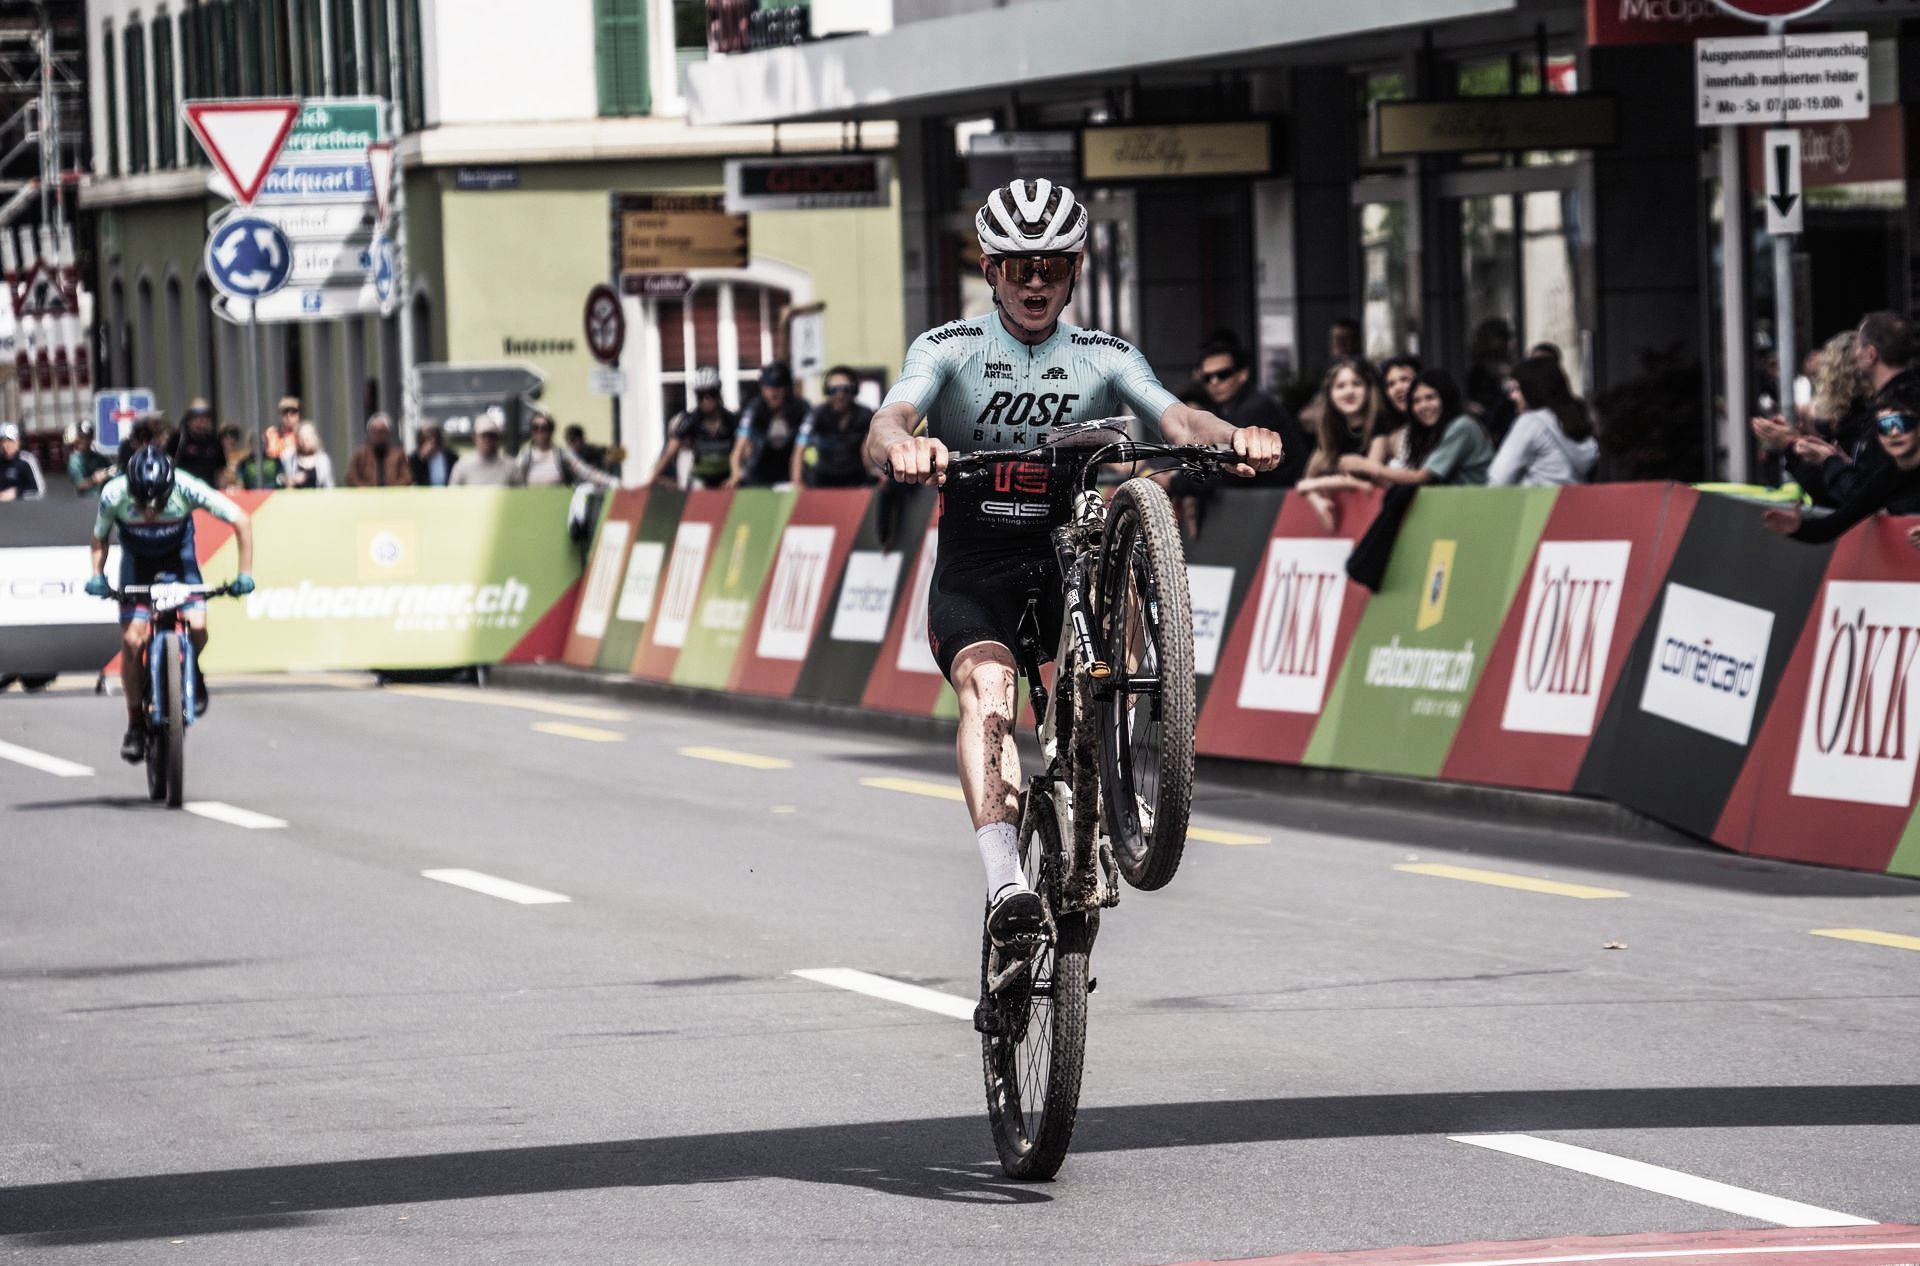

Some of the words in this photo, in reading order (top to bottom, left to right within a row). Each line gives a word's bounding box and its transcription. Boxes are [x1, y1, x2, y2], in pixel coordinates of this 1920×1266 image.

[1618, 0, 1722, 23] McOpt
[1701, 49, 1782, 65] Ausgenommen
[1706, 74, 1758, 88] innerhalb
[1760, 72, 1822, 86] markierten
[1825, 70, 1859, 84] Felder
[1718, 100, 1736, 113] Mo
[266, 165, 354, 195] ndquart
[926, 324, 984, 345] Traduction
[1070, 332, 1130, 353] Traduction
[984, 371, 1000, 379] ART
[985, 361, 1012, 371] wohn
[976, 391, 1080, 427] ROSE
[973, 429, 1048, 445] BIKE
[980, 500, 1050, 517] GIS
[246, 576, 529, 620] velocorner.ch
[1258, 560, 1339, 678] ÖKK
[1526, 565, 1614, 696] ÖKK
[1816, 606, 1920, 761] ÖKK
